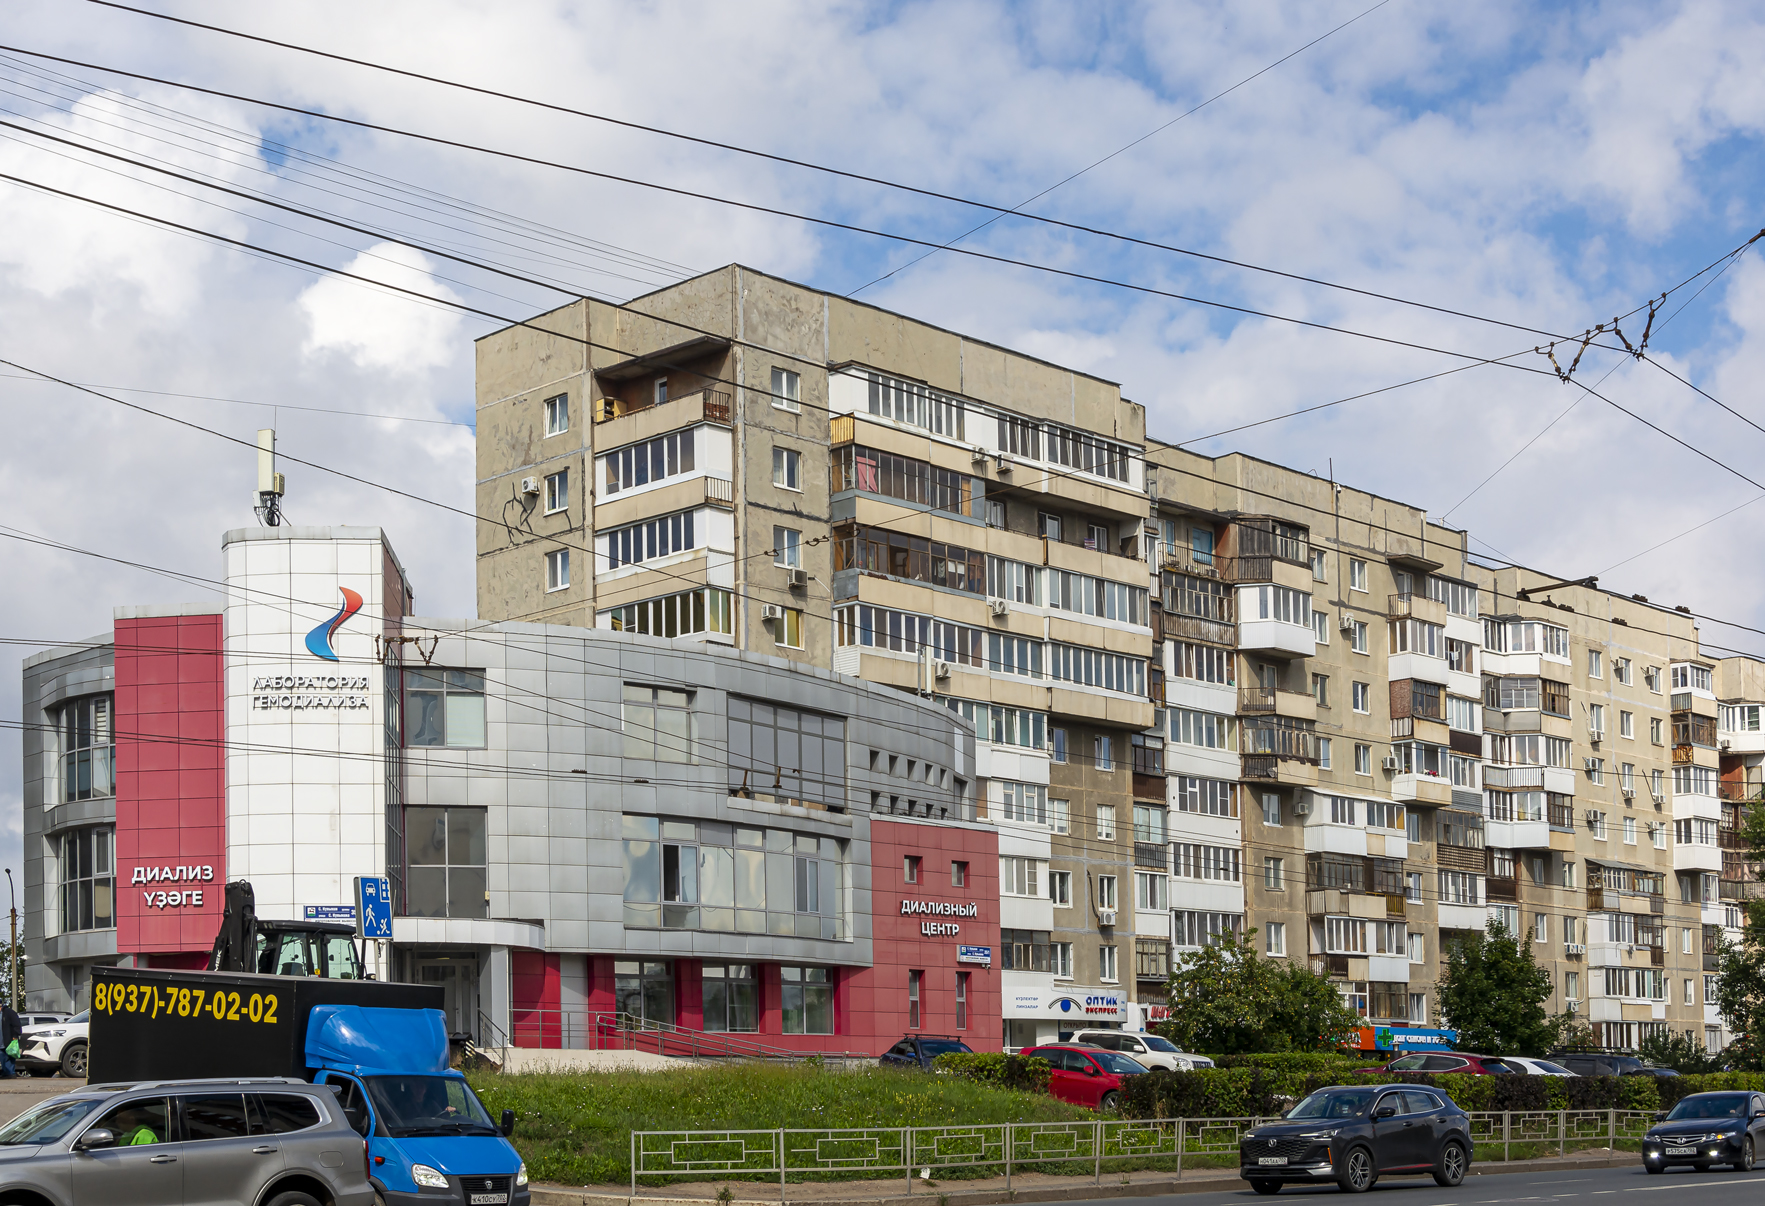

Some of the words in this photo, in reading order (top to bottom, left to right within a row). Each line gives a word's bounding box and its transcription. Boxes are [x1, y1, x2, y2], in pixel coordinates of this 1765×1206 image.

[253, 676, 369, 691] ЛАБОРАТОРИЯ
[253, 695, 369, 710] ГЕМОДИАЛИЗА
[131, 865, 214, 885] ДИАЛИЗ
[901, 899, 978, 918] ДИАЛИЗНЫЙ
[921, 922, 960, 936] ЦЕНТР
[94, 982, 278, 1024] 8(937)-787-02-02
[1085, 996, 1118, 1006] ОПТИК
[1085, 1006, 1118, 1015] ЭКСПРЕСС
